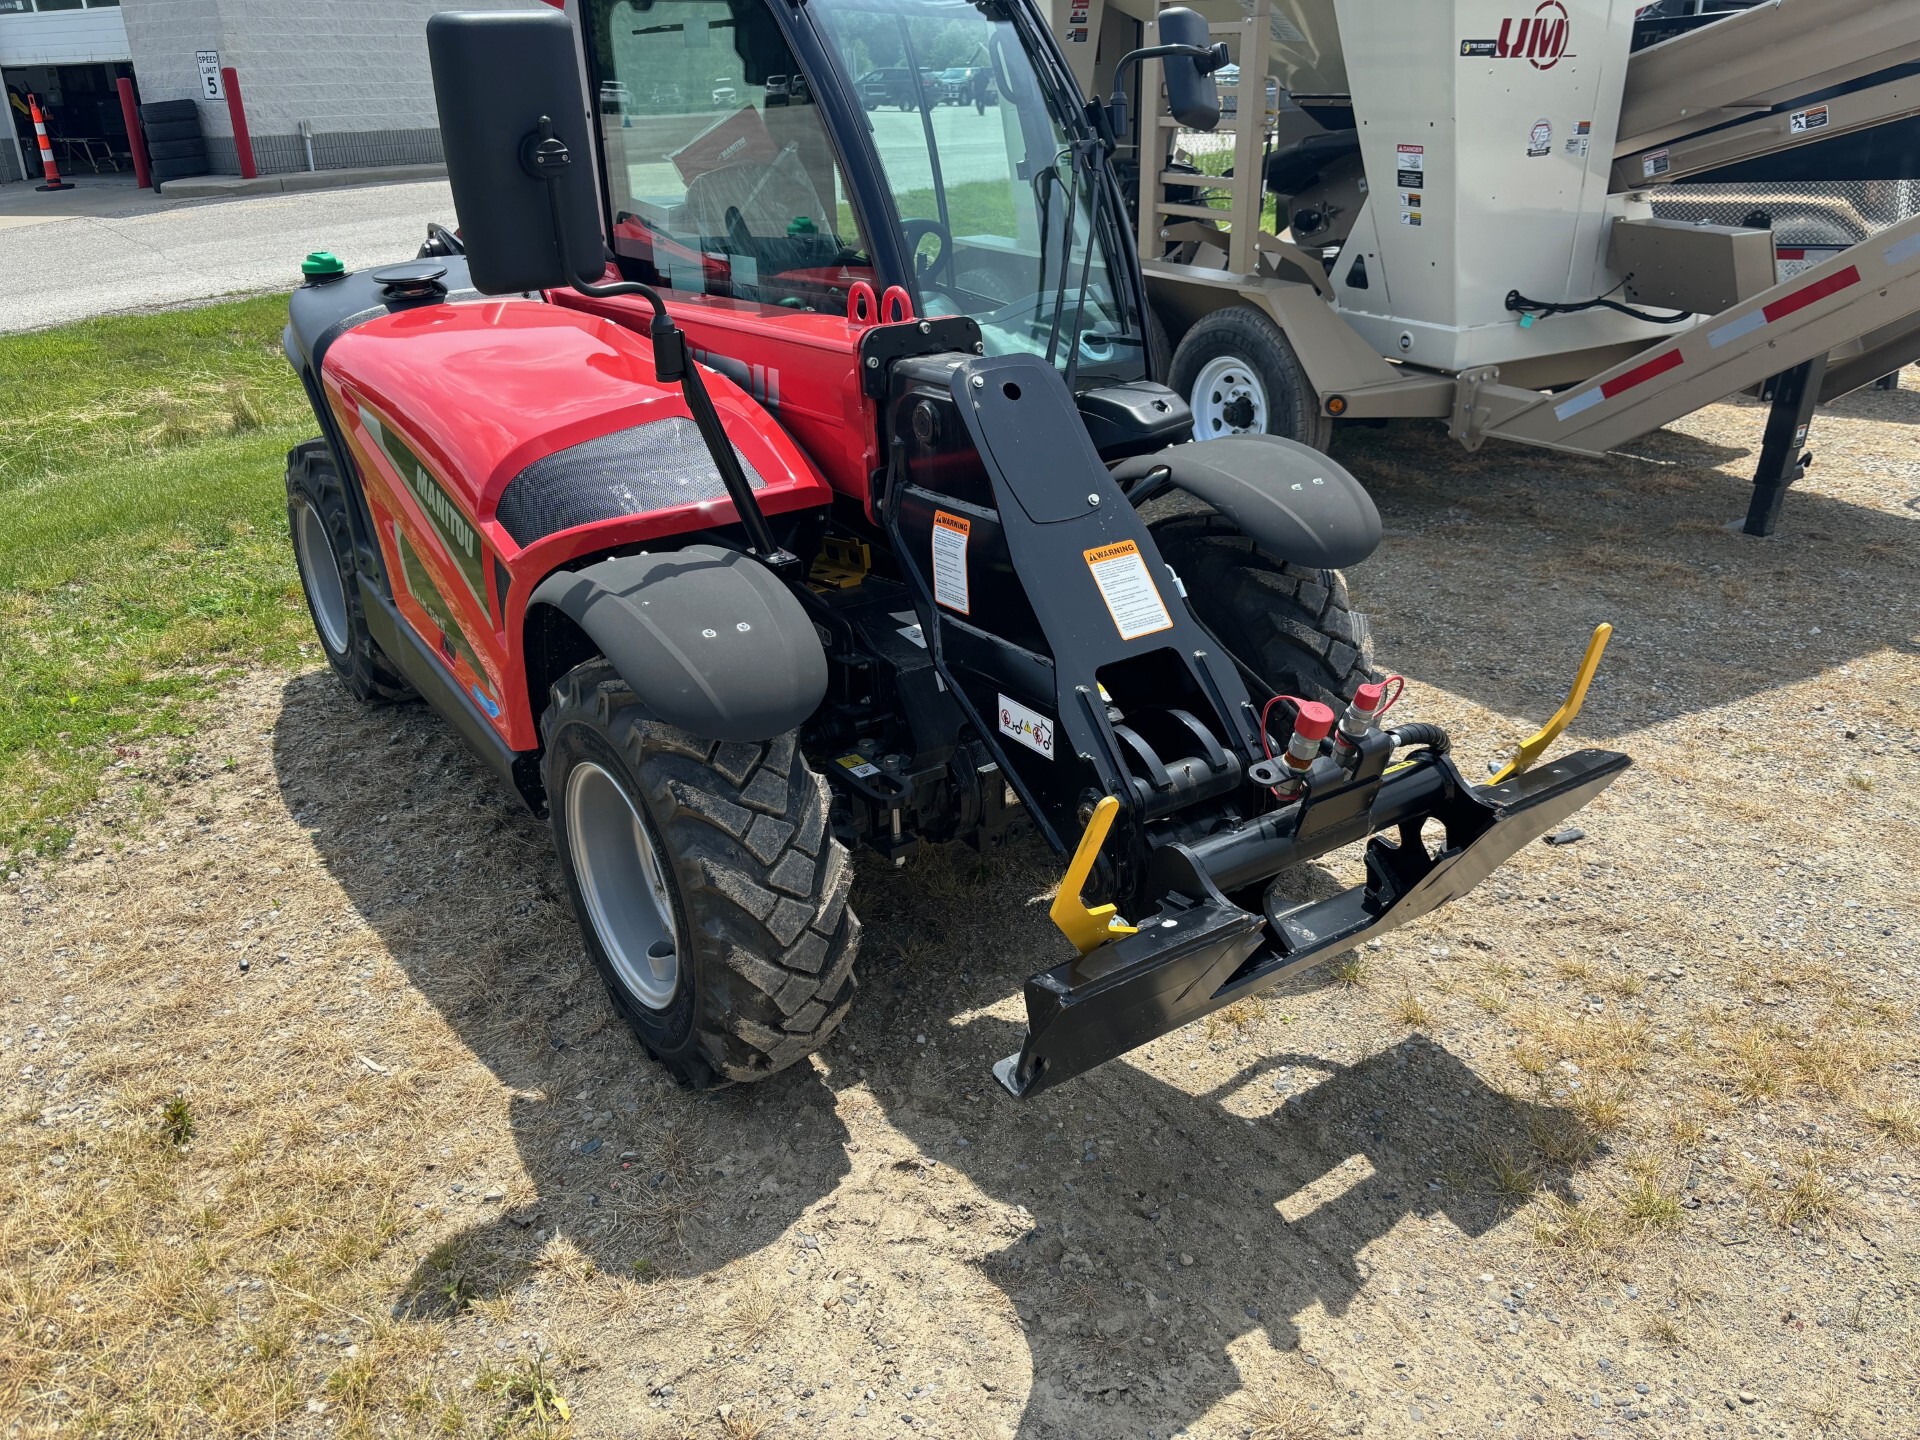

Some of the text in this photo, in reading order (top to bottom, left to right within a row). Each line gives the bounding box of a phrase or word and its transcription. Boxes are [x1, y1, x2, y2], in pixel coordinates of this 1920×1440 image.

[198, 55, 217, 64] SPEED
[202, 66, 217, 75] LIMIT
[207, 76, 218, 95] 5
[1534, 127, 1550, 142] 75
[721, 136, 747, 160] MANITOU
[416, 464, 474, 558] MANITOU
[941, 516, 968, 532] WARNING
[1096, 544, 1135, 559] WARNING
